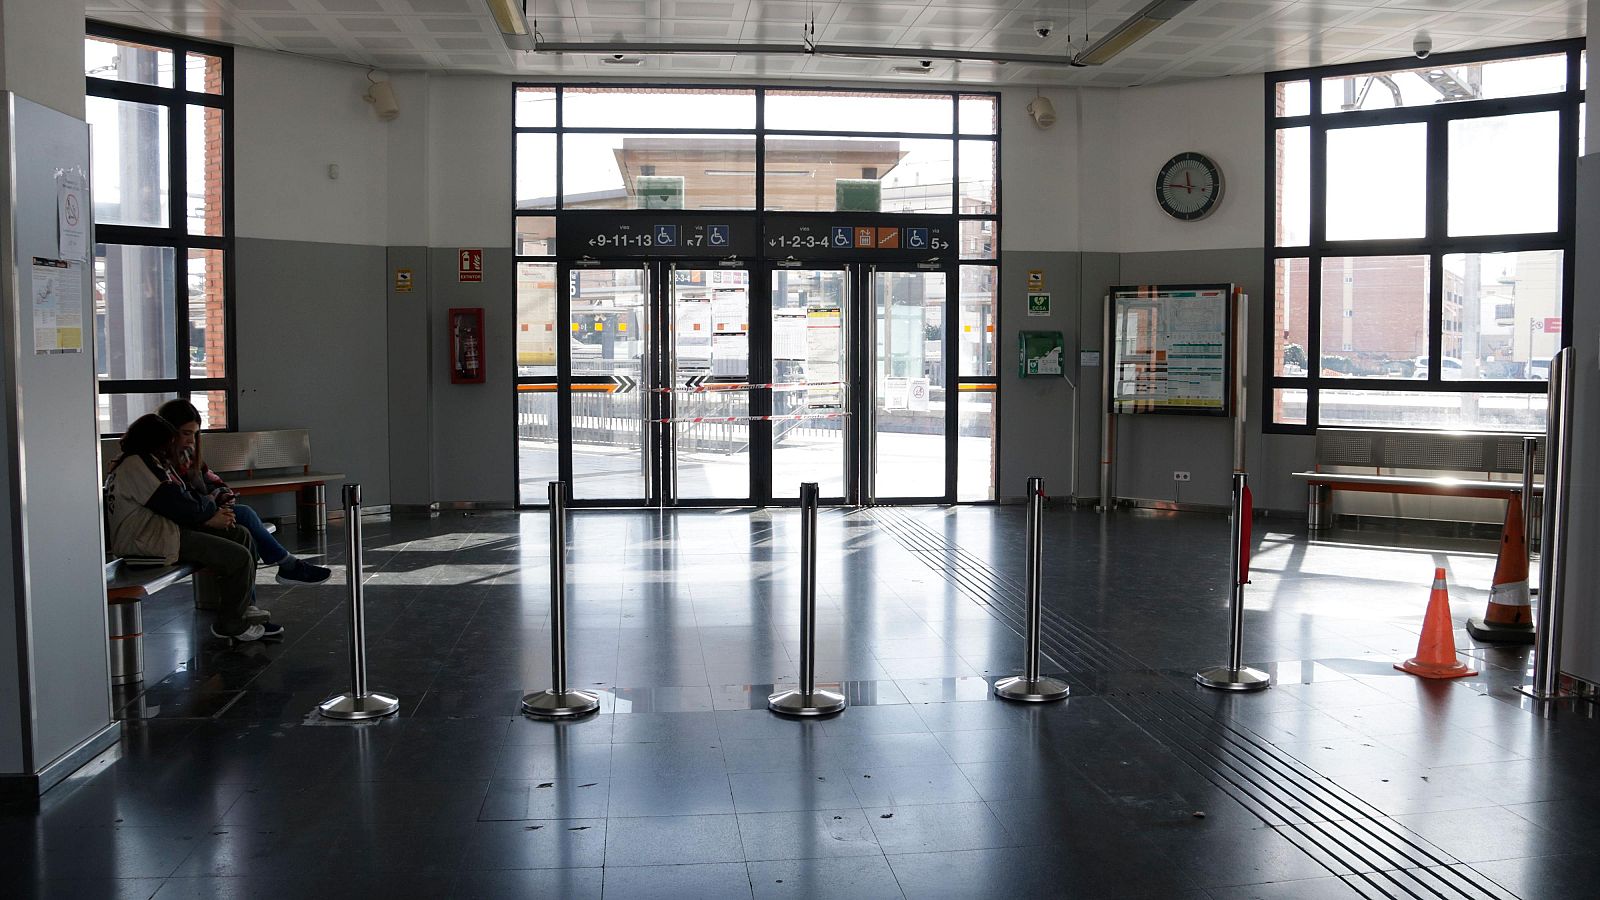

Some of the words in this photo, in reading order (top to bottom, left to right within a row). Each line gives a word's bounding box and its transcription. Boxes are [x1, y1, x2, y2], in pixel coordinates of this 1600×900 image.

[597, 234, 652, 247] 9-11-13
[694, 234, 703, 247] 7
[778, 235, 830, 248] 1-2-3-4
[931, 237, 940, 250] 5
